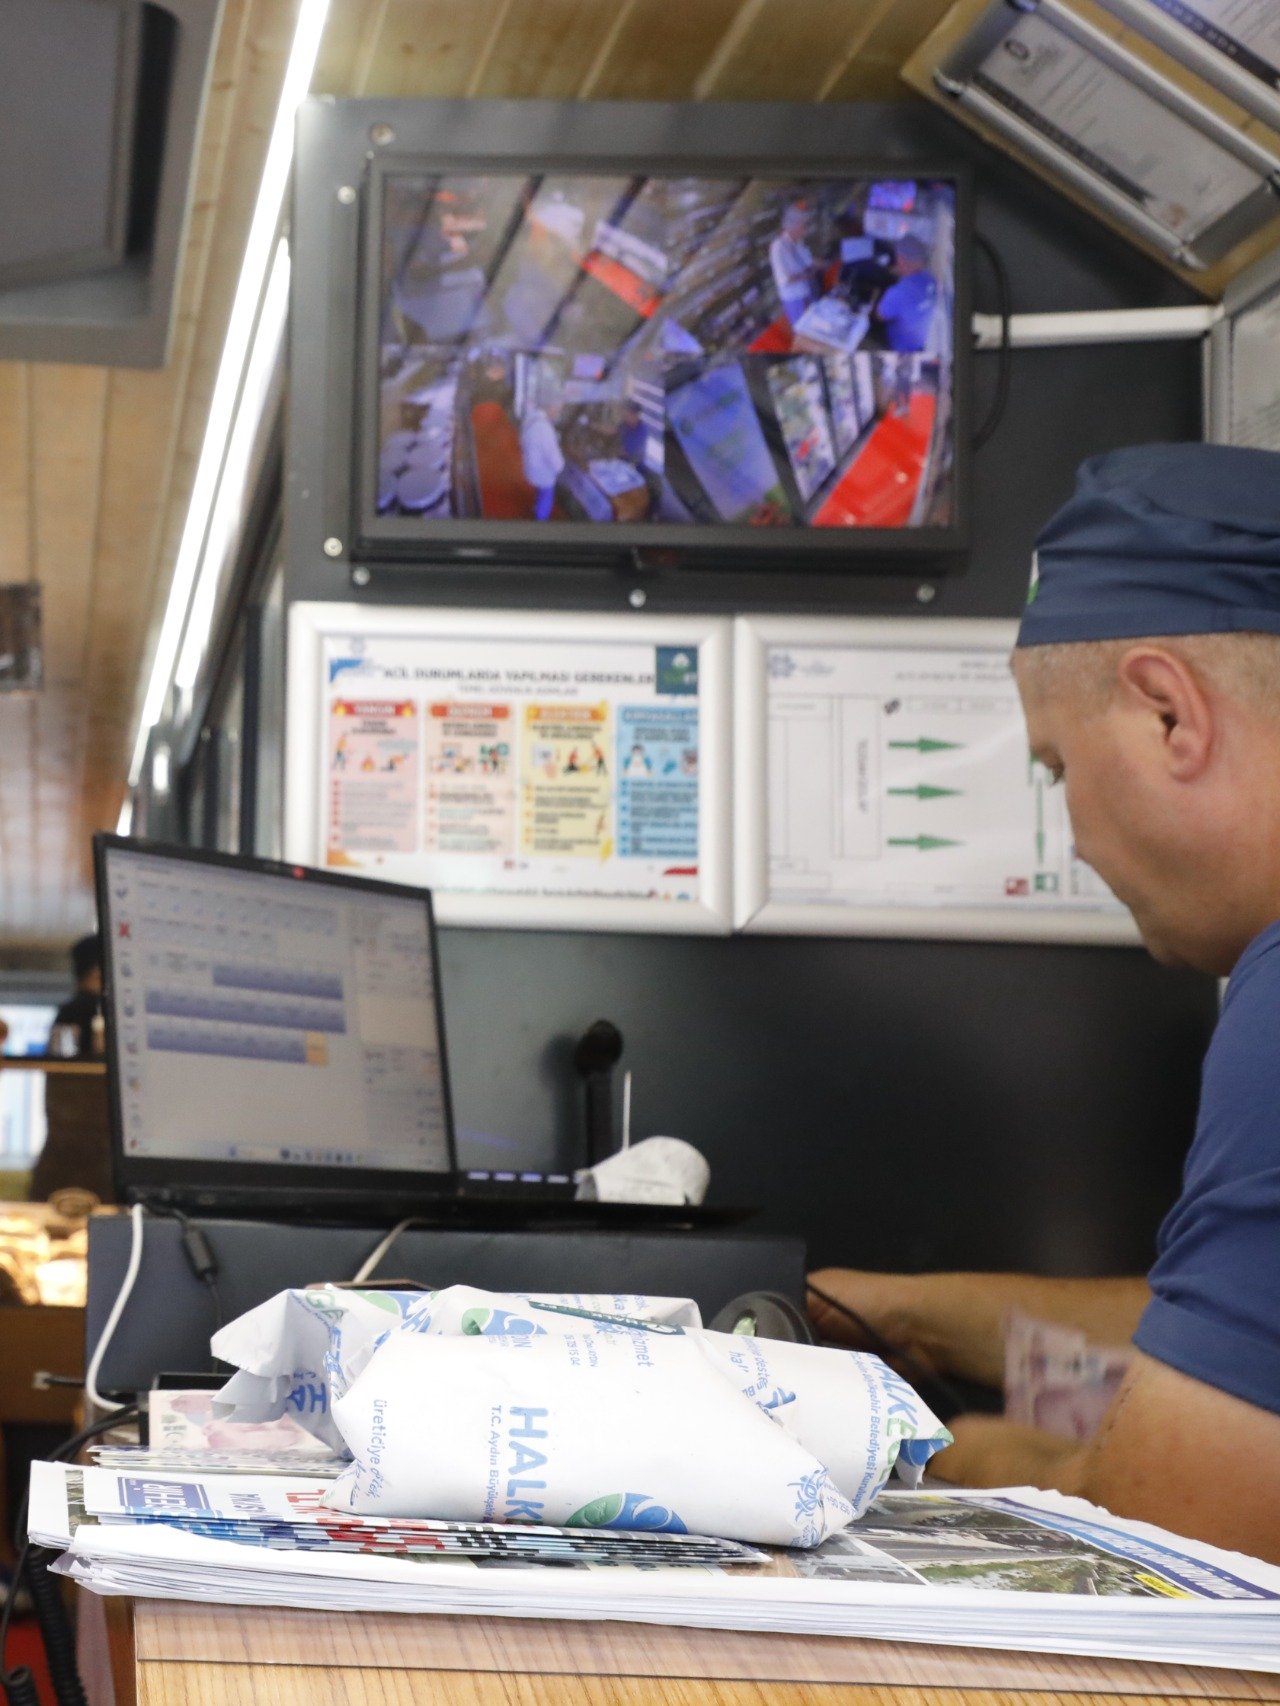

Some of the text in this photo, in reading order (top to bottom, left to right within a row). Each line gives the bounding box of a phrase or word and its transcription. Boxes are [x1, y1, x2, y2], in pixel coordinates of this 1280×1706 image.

[367, 1399, 387, 1465] üreticiye
[491, 1405, 502, 1427] T.C.
[488, 1430, 501, 1466] Aydın
[866, 1416, 881, 1472] Belediyesi
